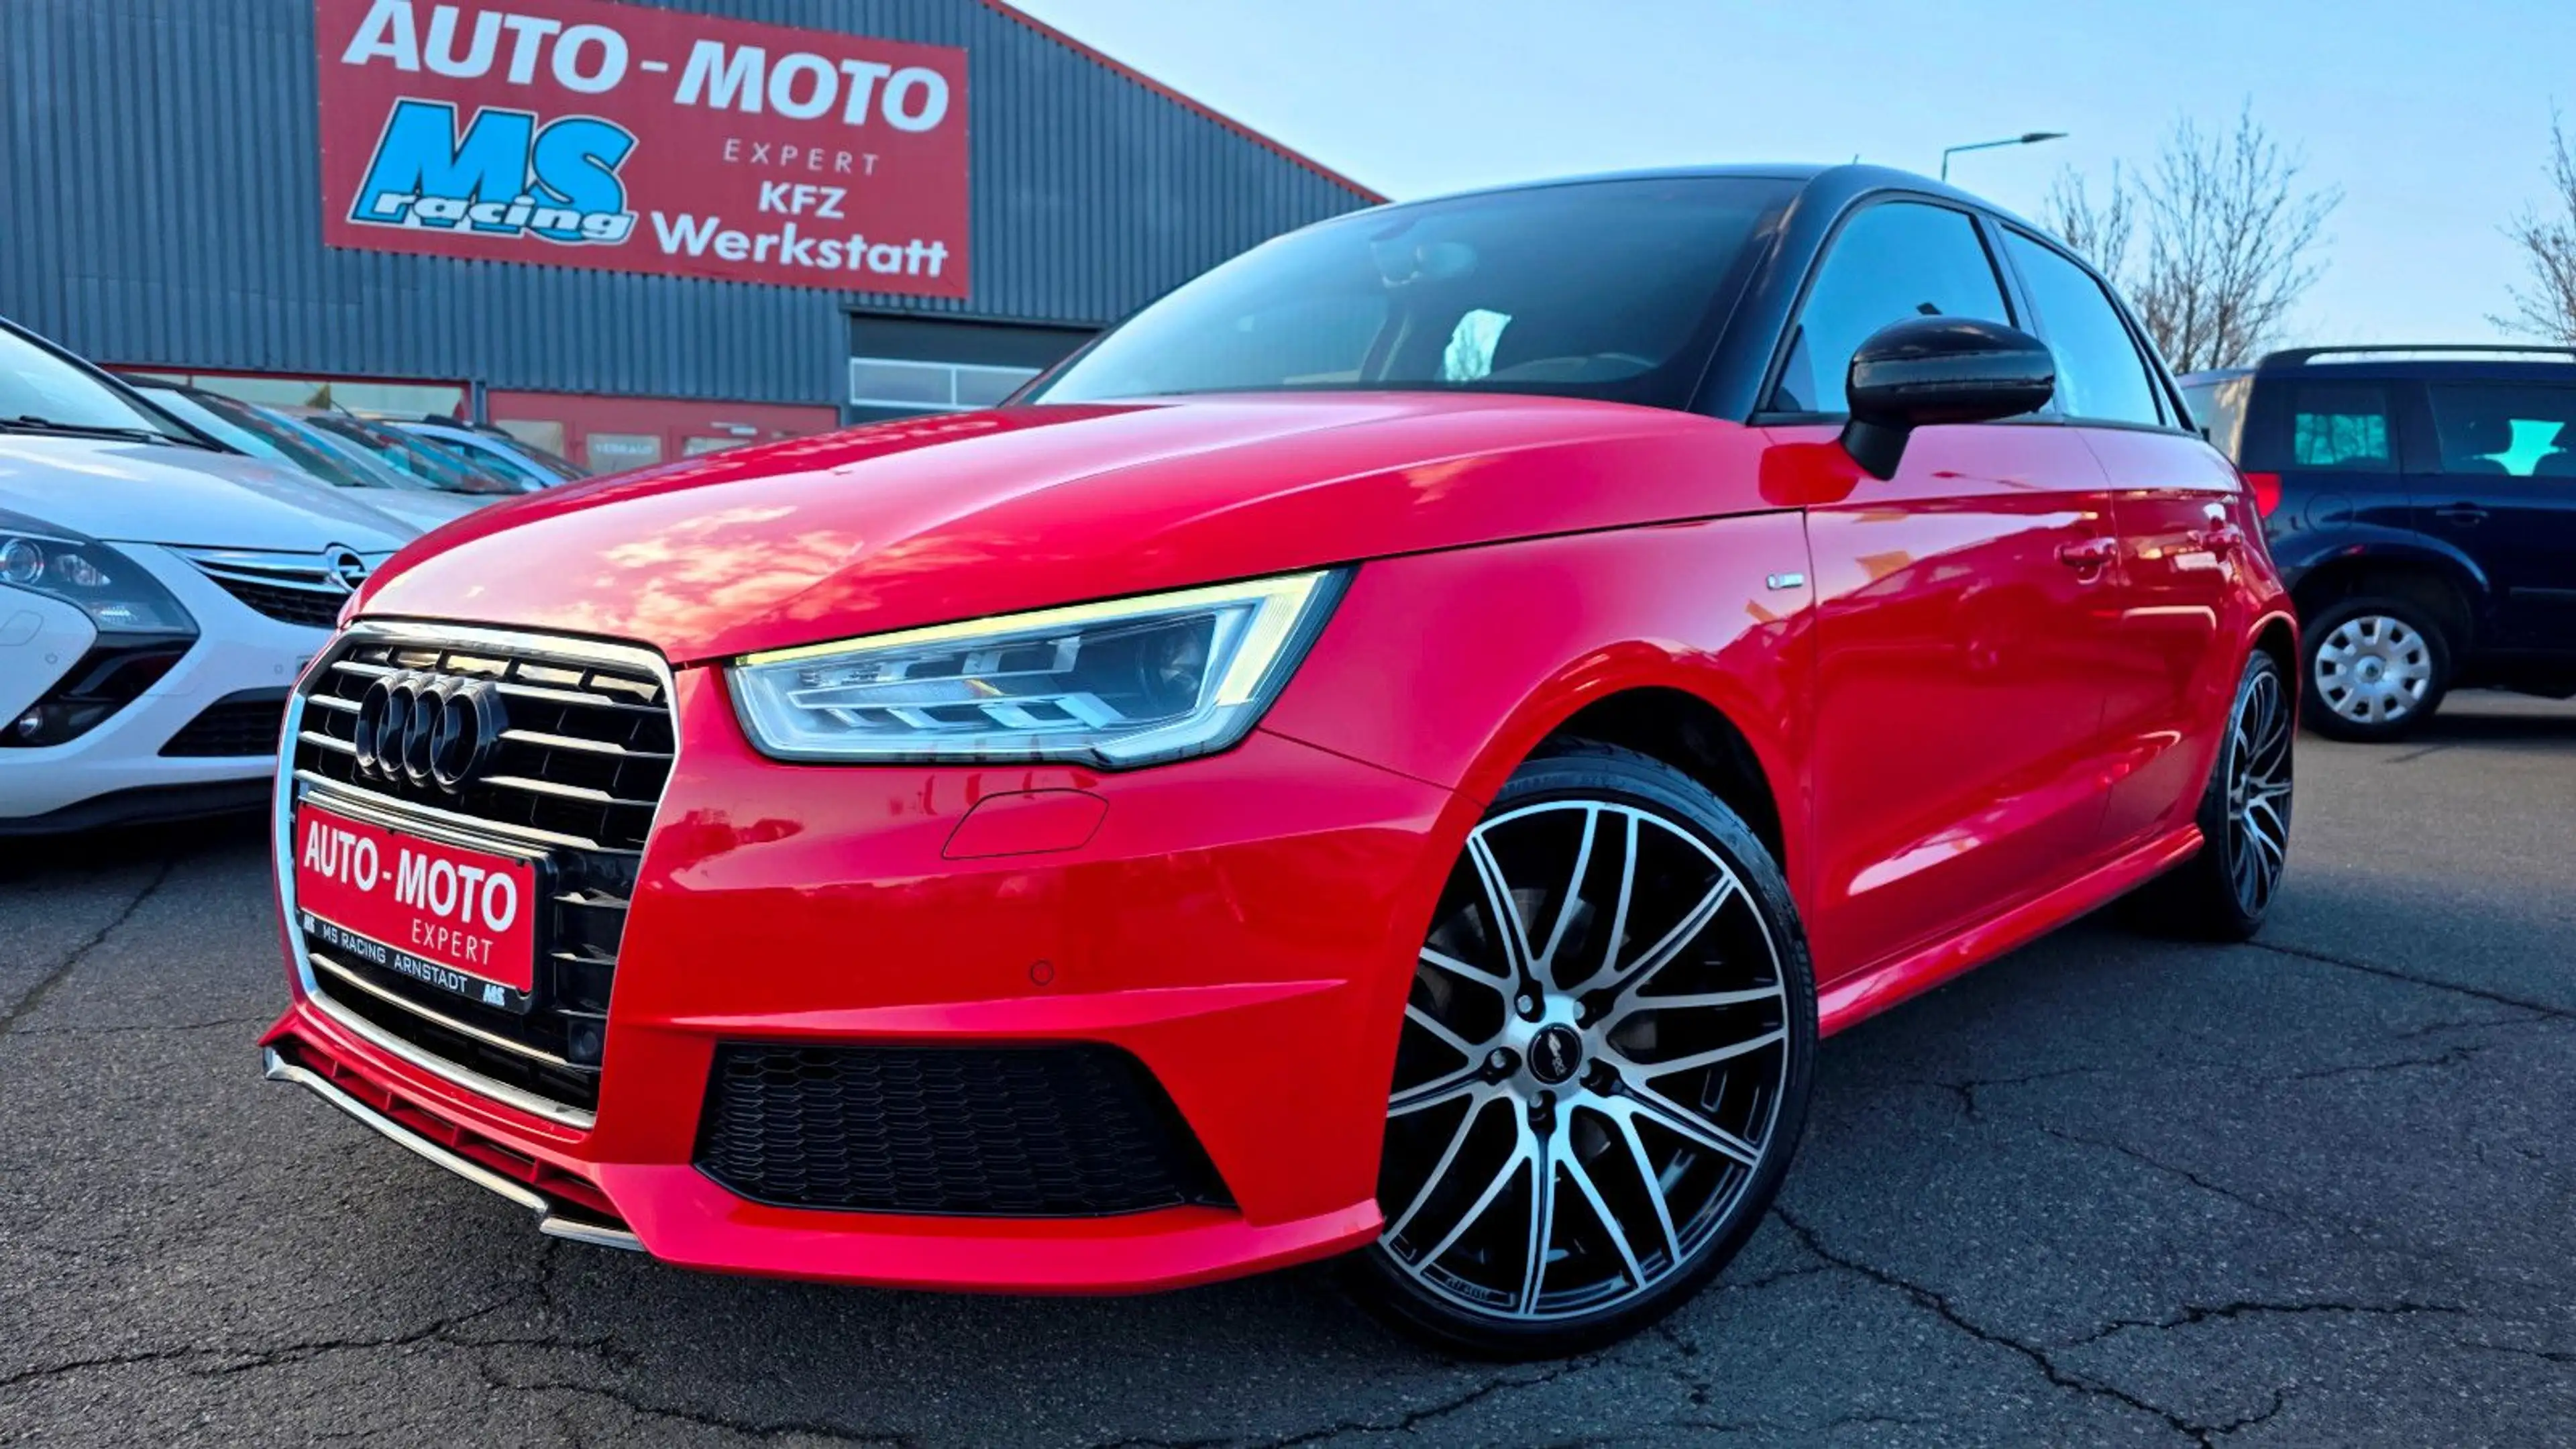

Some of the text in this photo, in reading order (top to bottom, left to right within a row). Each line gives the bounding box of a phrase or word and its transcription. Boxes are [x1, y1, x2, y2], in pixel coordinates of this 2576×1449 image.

[346, 96, 639, 246] MS
[723, 138, 879, 176] EXPERT
[371, 191, 638, 244] racing
[758, 180, 847, 219] KFZ
[650, 210, 949, 277] Werkstatt
[323, 924, 338, 944] MS
[341, 932, 386, 965] RACING
[394, 953, 468, 994] ARNSTADT
[412, 918, 494, 966] EXPERT
